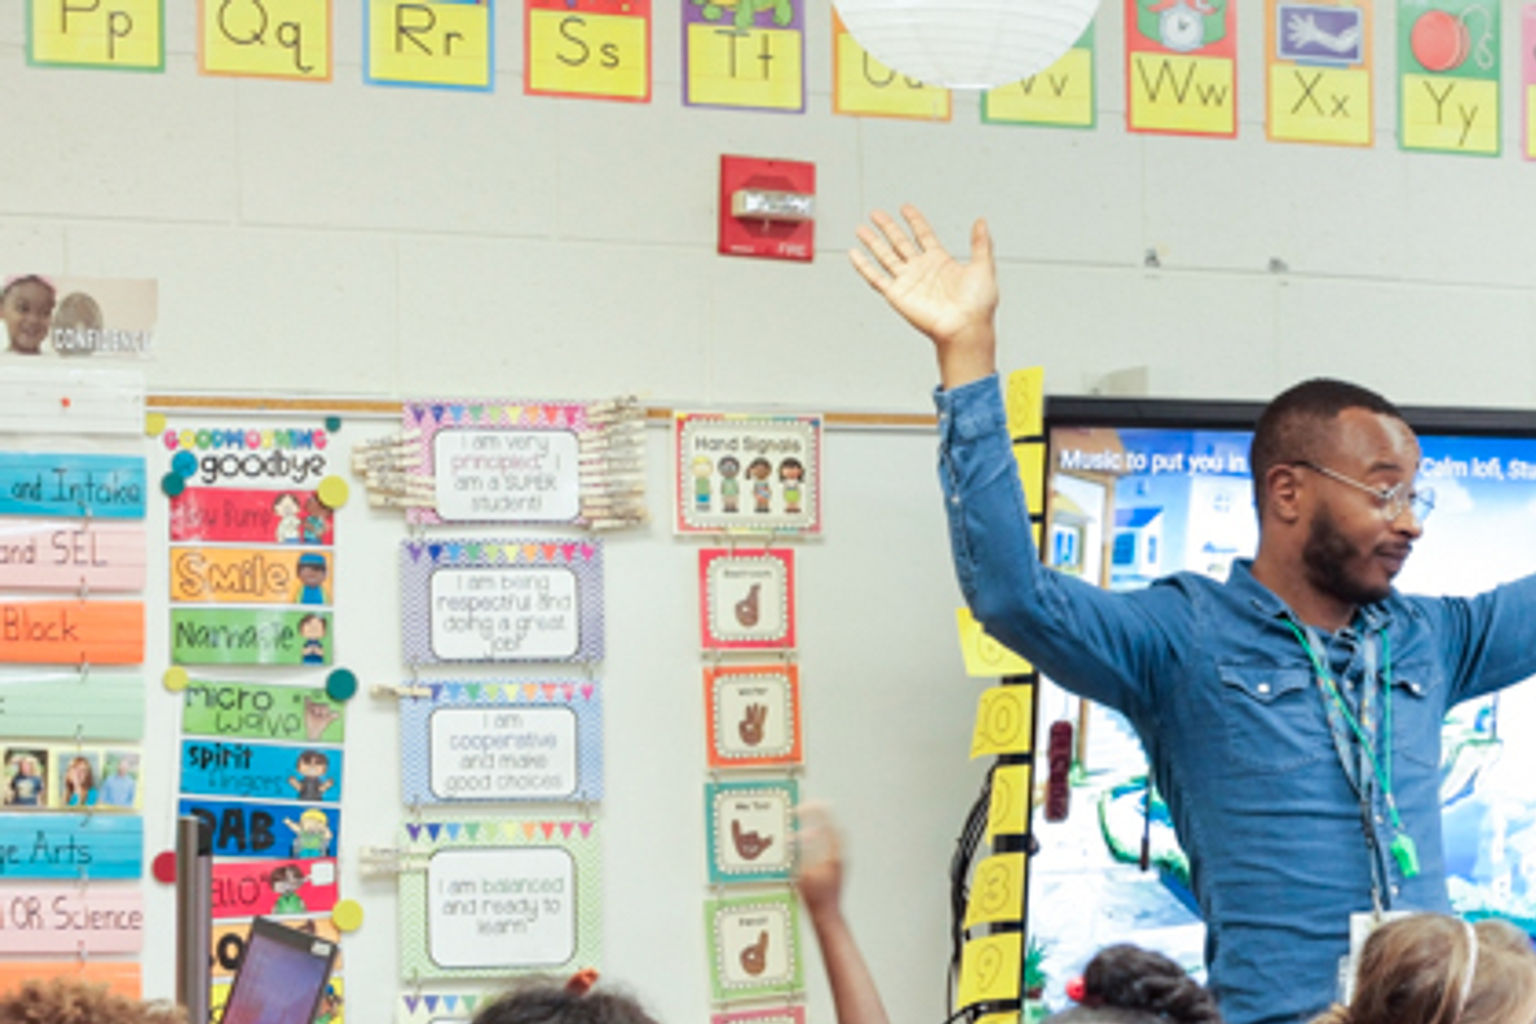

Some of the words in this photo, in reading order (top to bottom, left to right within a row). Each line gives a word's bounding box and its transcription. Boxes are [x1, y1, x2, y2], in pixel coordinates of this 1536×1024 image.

[394, 3, 463, 56] Rr
[556, 15, 620, 69] Ss
[1136, 58, 1228, 108] Ww
[1290, 69, 1350, 119] Xx
[1422, 80, 1479, 147] Yy
[1060, 448, 1122, 470] Music
[1126, 451, 1148, 470] to
[1151, 453, 1184, 475] put
[1188, 454, 1224, 476] you
[1420, 457, 1468, 478] Calm
[51, 530, 108, 567] SEL
[176, 552, 291, 597] Smile
